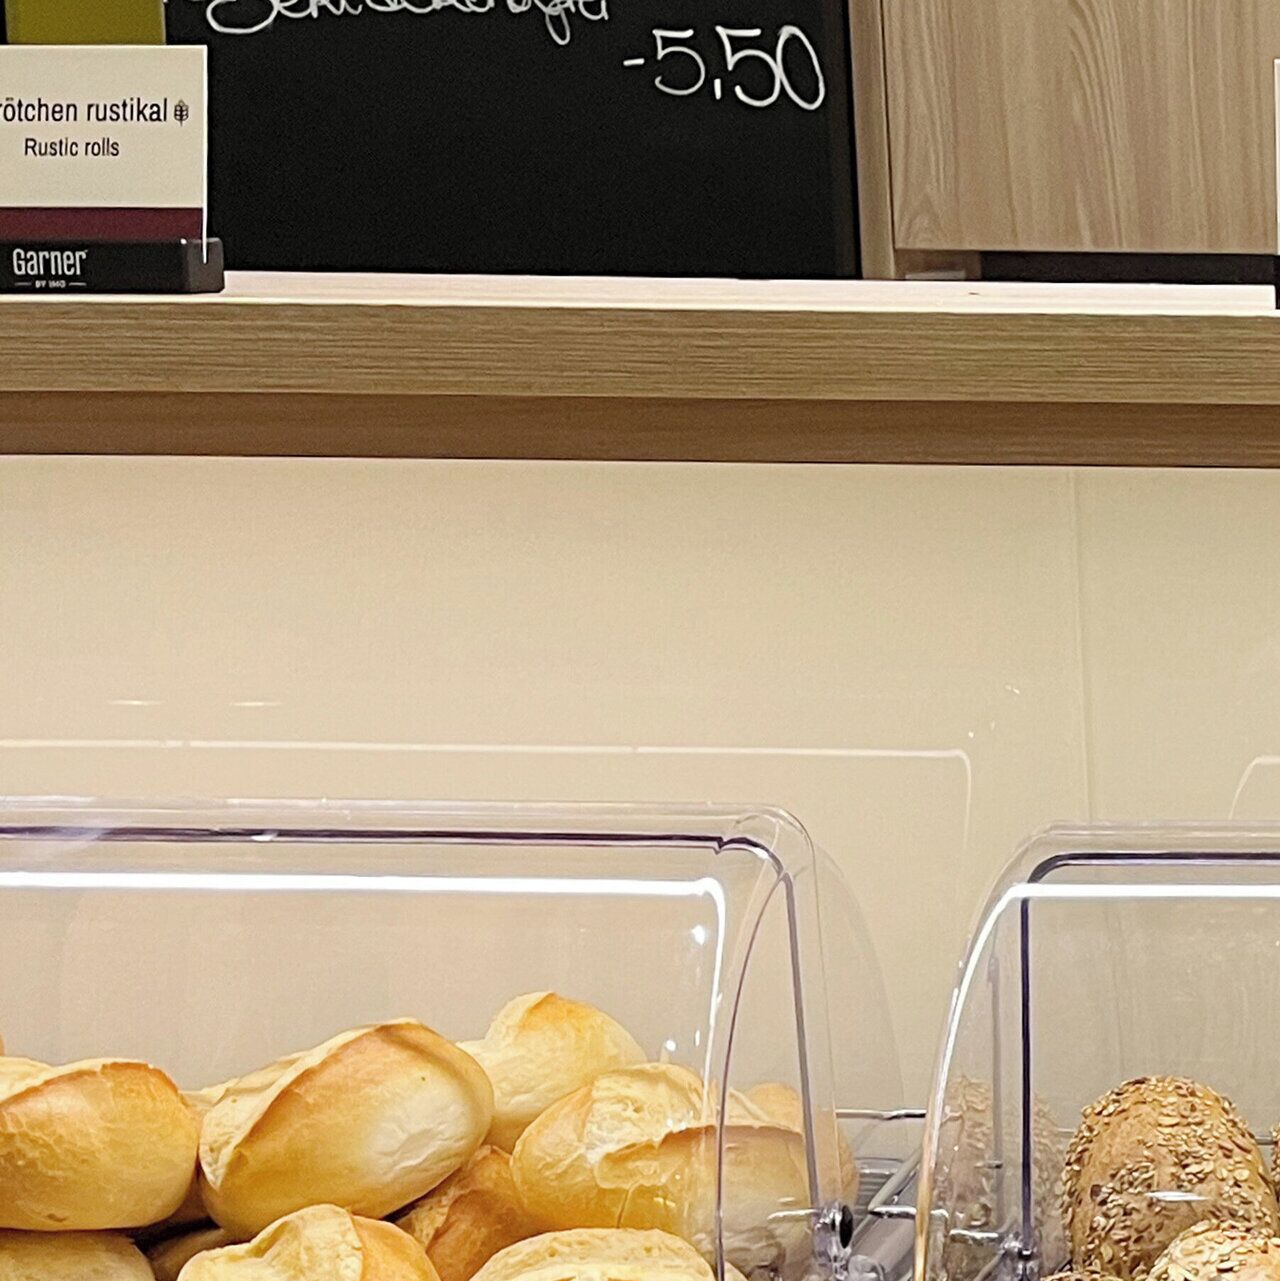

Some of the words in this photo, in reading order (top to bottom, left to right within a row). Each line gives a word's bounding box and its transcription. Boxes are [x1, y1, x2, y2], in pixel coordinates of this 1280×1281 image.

[86, 97, 168, 122] rustikal
[24, 137, 79, 157] Rustic
[84, 137, 120, 157] rolls
[12, 248, 87, 275] Garner
